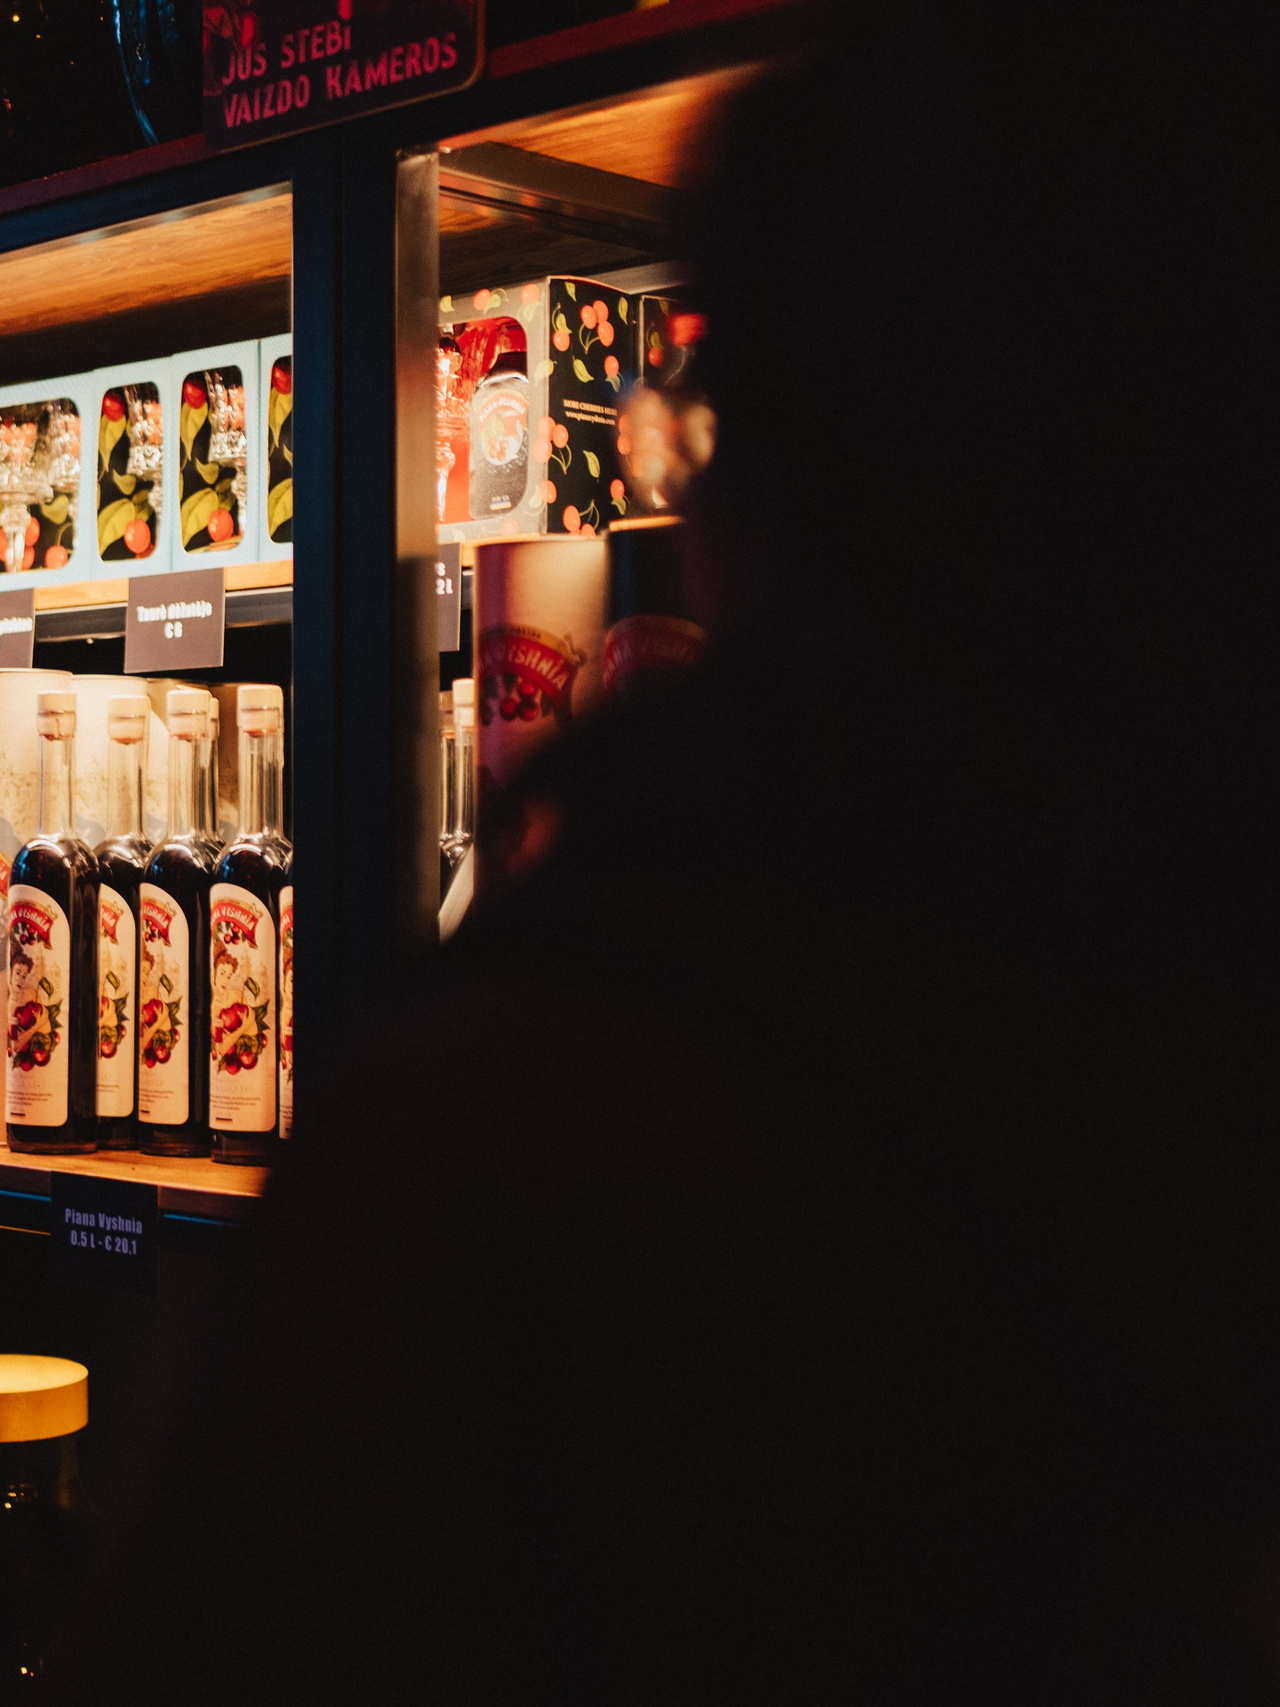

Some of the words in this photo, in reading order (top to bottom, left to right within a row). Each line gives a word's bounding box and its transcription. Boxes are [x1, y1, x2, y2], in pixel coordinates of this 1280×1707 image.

[222, 75, 311, 128] VAIZDO
[325, 31, 459, 100] KAMEROS
[65, 1207, 96, 1227] Piana
[98, 1212, 143, 1235] Vyshnia
[70, 1229, 88, 1248] 0.5
